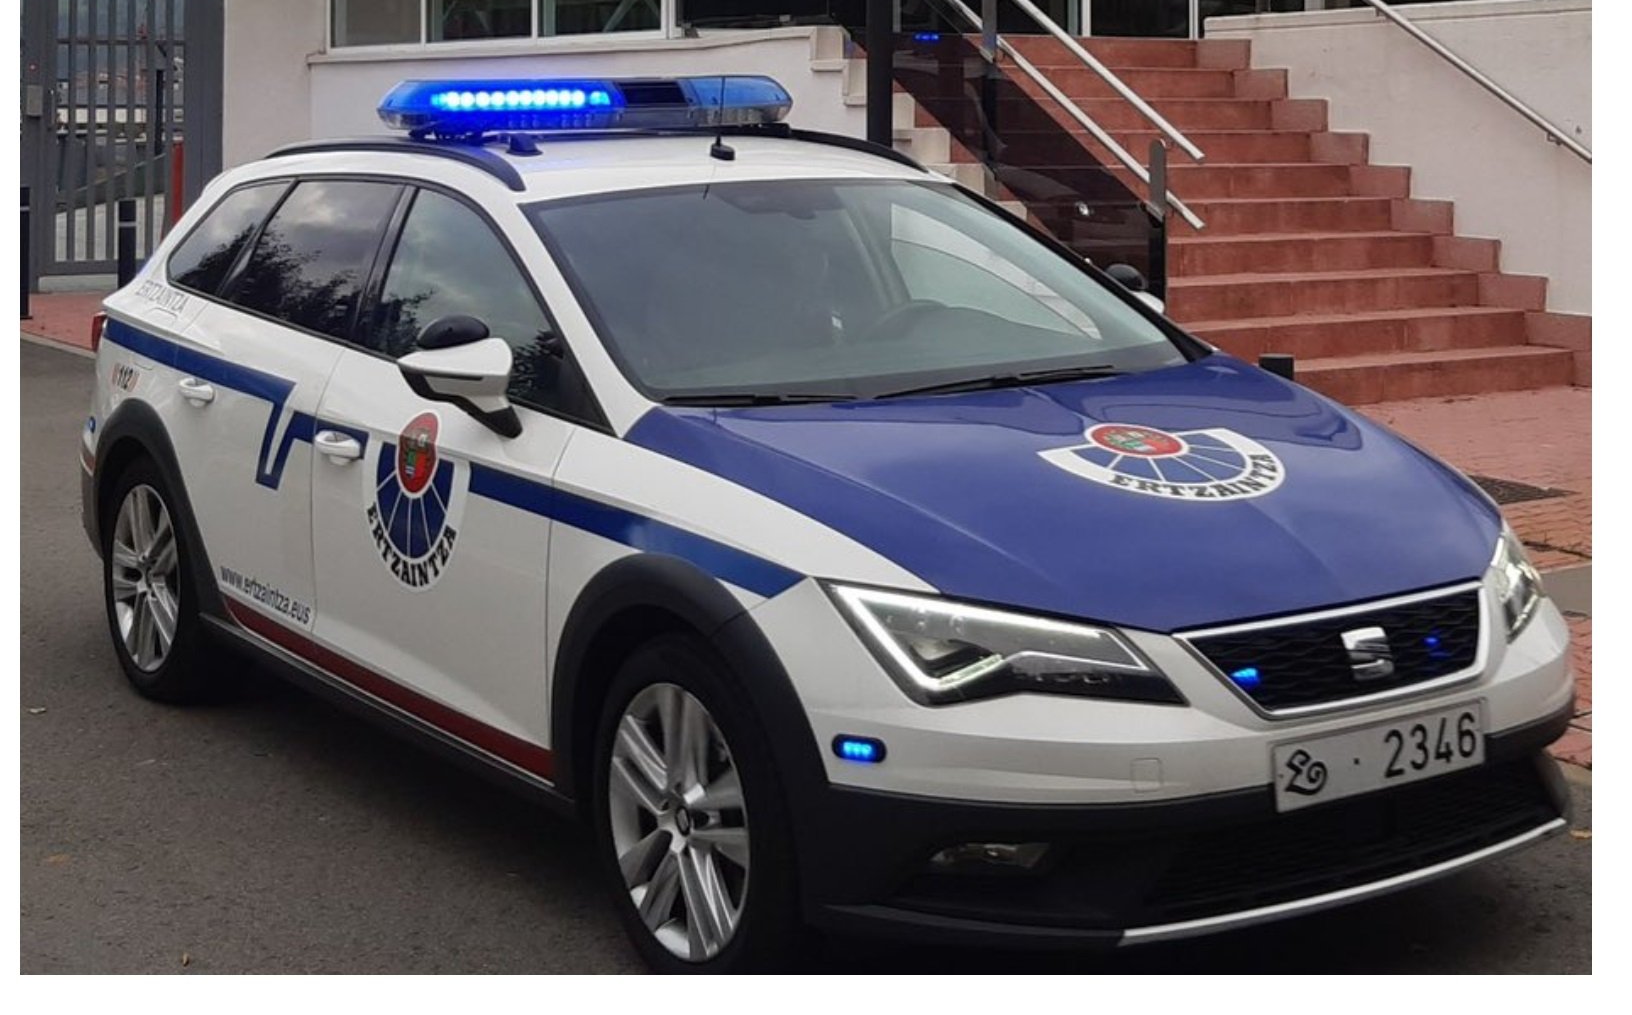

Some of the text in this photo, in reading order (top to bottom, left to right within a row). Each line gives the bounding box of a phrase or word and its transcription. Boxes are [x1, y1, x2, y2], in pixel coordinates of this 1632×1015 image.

[1110, 453, 1278, 498] ERTZAINTZA
[367, 501, 457, 588] ERTZAINTZA
[220, 566, 311, 625] www.ertzaintza.eus
[1383, 711, 1476, 779] 2346
